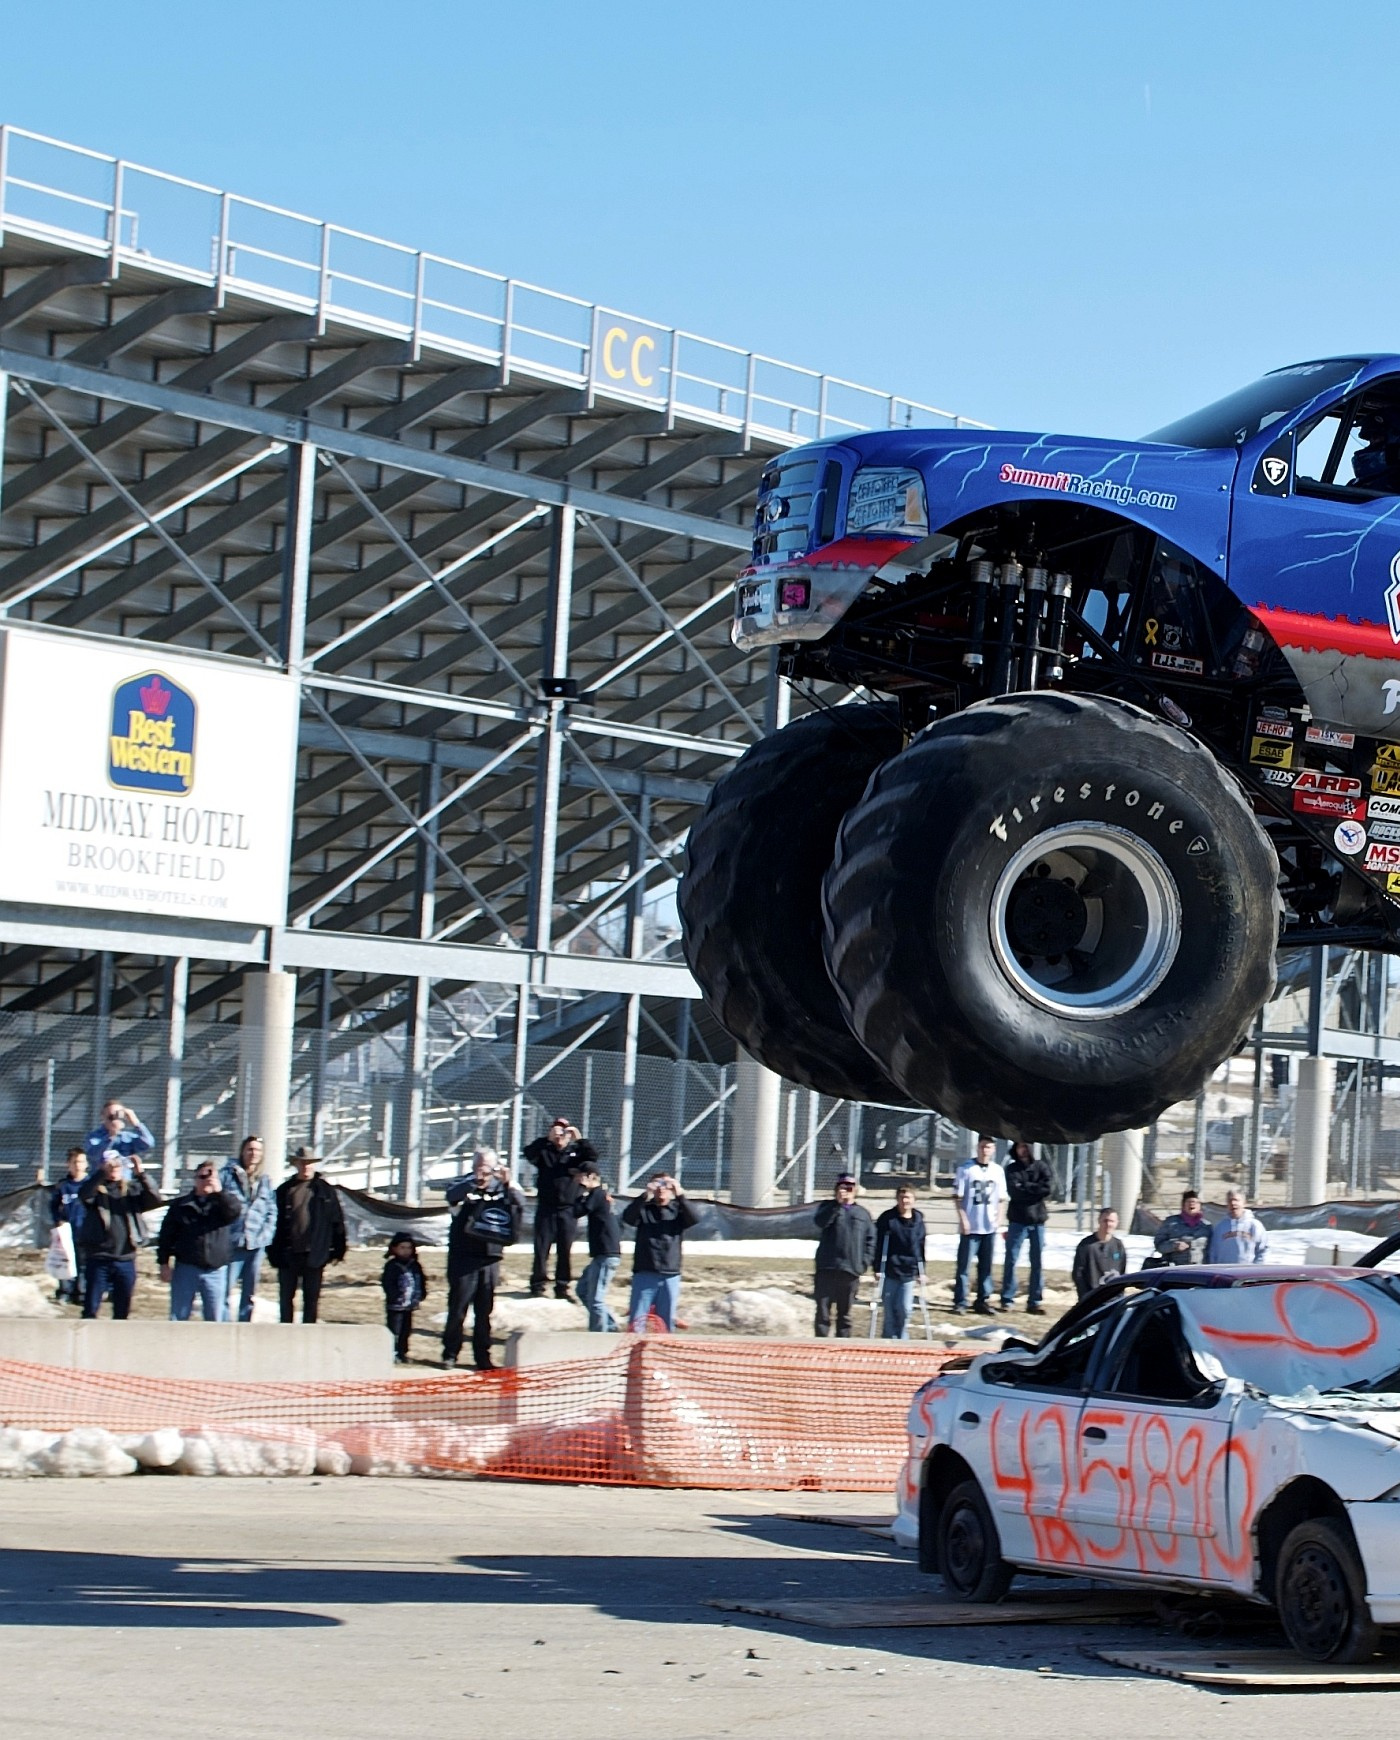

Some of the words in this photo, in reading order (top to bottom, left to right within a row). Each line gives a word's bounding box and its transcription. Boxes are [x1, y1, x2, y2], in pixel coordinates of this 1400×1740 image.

[602, 328, 655, 387] CC
[999, 464, 1177, 510] SummitRacing.com
[129, 710, 175, 747] Best
[1257, 722, 1288, 736] JET-HOT
[110, 736, 192, 787] Western
[1259, 746, 1284, 758] ESAB
[1295, 773, 1360, 792] ARP
[42, 790, 153, 838] MIDWAY
[162, 805, 250, 850] HOTEL
[989, 781, 1183, 842] Firestone
[67, 842, 226, 882] BROOKFIELD
